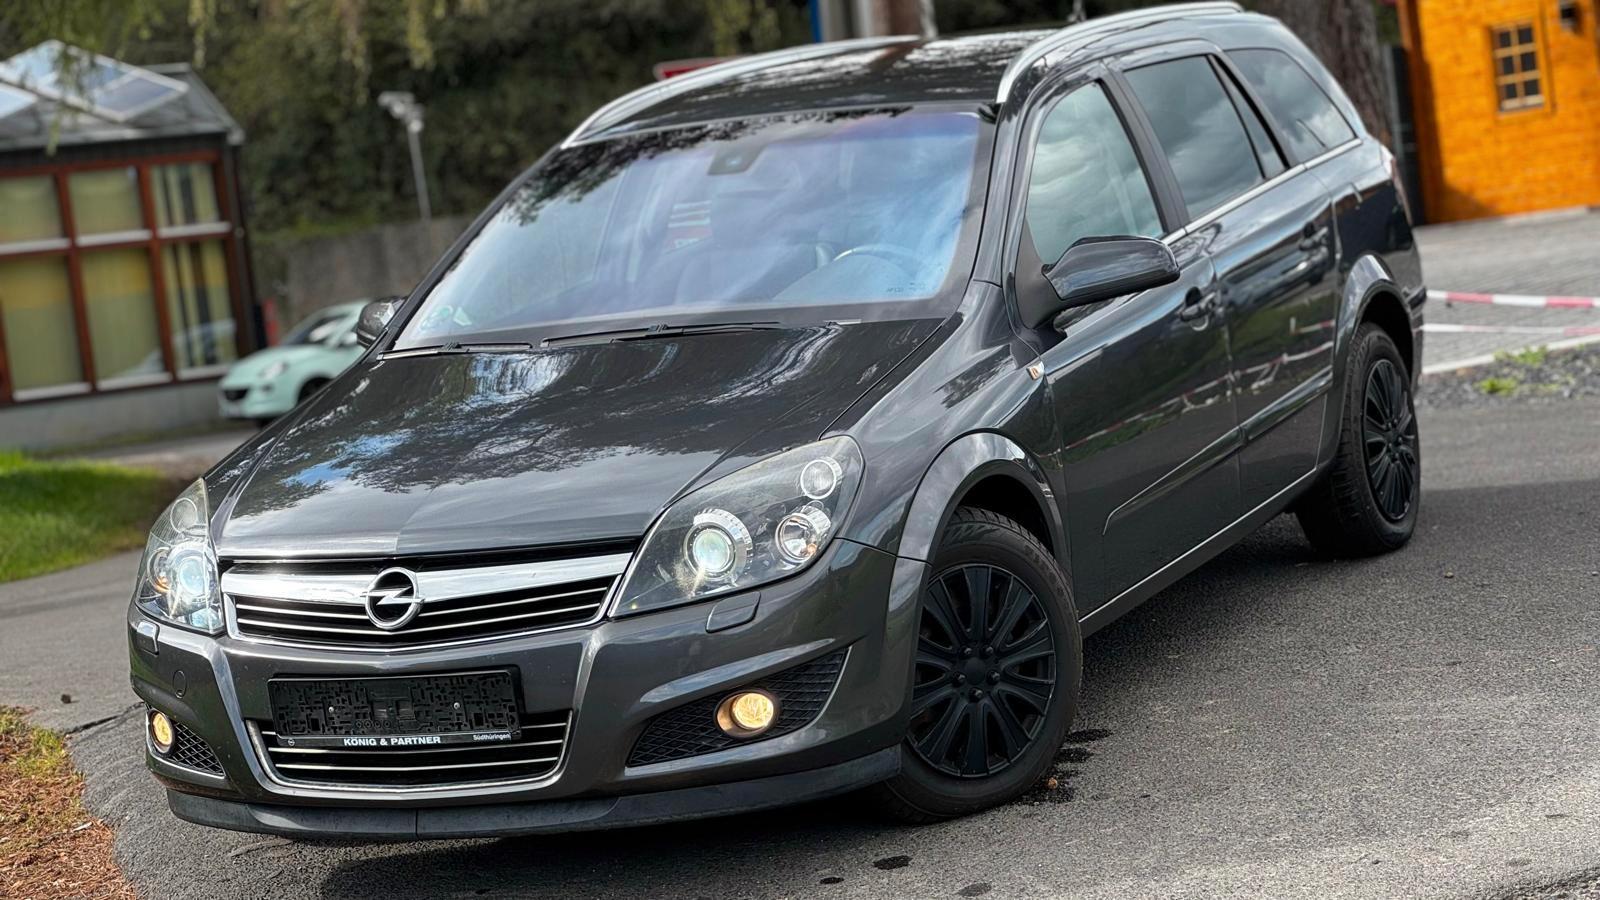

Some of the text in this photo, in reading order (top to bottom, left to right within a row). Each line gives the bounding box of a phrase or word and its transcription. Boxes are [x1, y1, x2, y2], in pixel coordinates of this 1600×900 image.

[343, 736, 441, 746] KÖNIG & PARTNER
